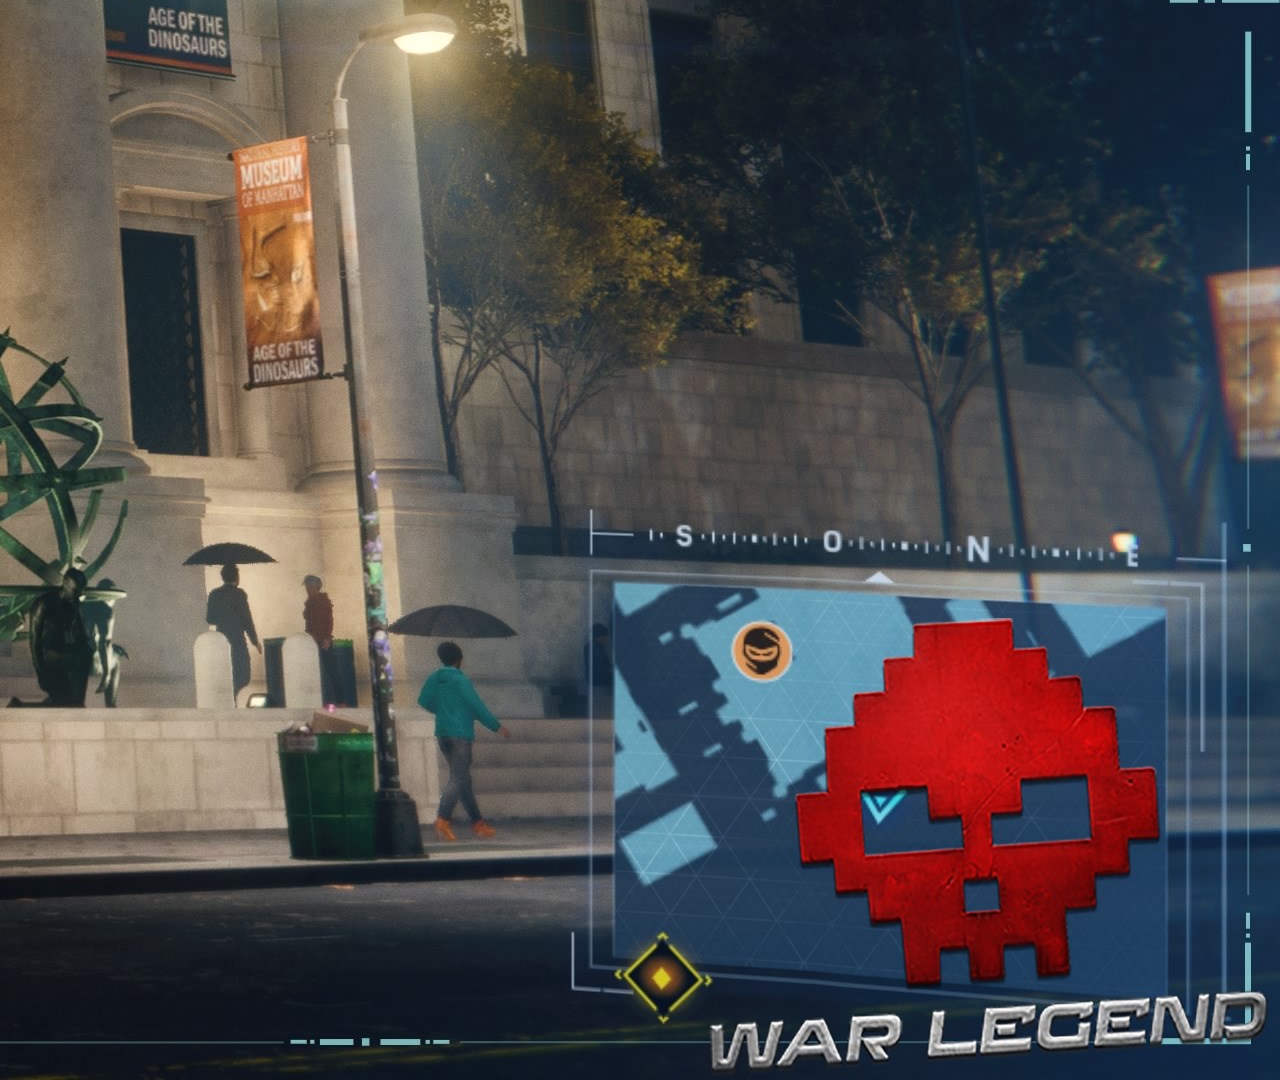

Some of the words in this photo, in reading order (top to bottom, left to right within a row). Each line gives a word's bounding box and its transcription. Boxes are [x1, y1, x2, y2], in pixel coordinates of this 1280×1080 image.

[148, 6, 176, 28] AGE
[178, 11, 196, 31] OF
[197, 13, 224, 36] THE
[148, 28, 228, 58] DINOSAURS
[240, 154, 303, 190] MUSEUM
[253, 343, 277, 361] AGE
[277, 341, 293, 358] OF
[293, 338, 316, 357] THE
[253, 356, 319, 383] DINOSAURS
